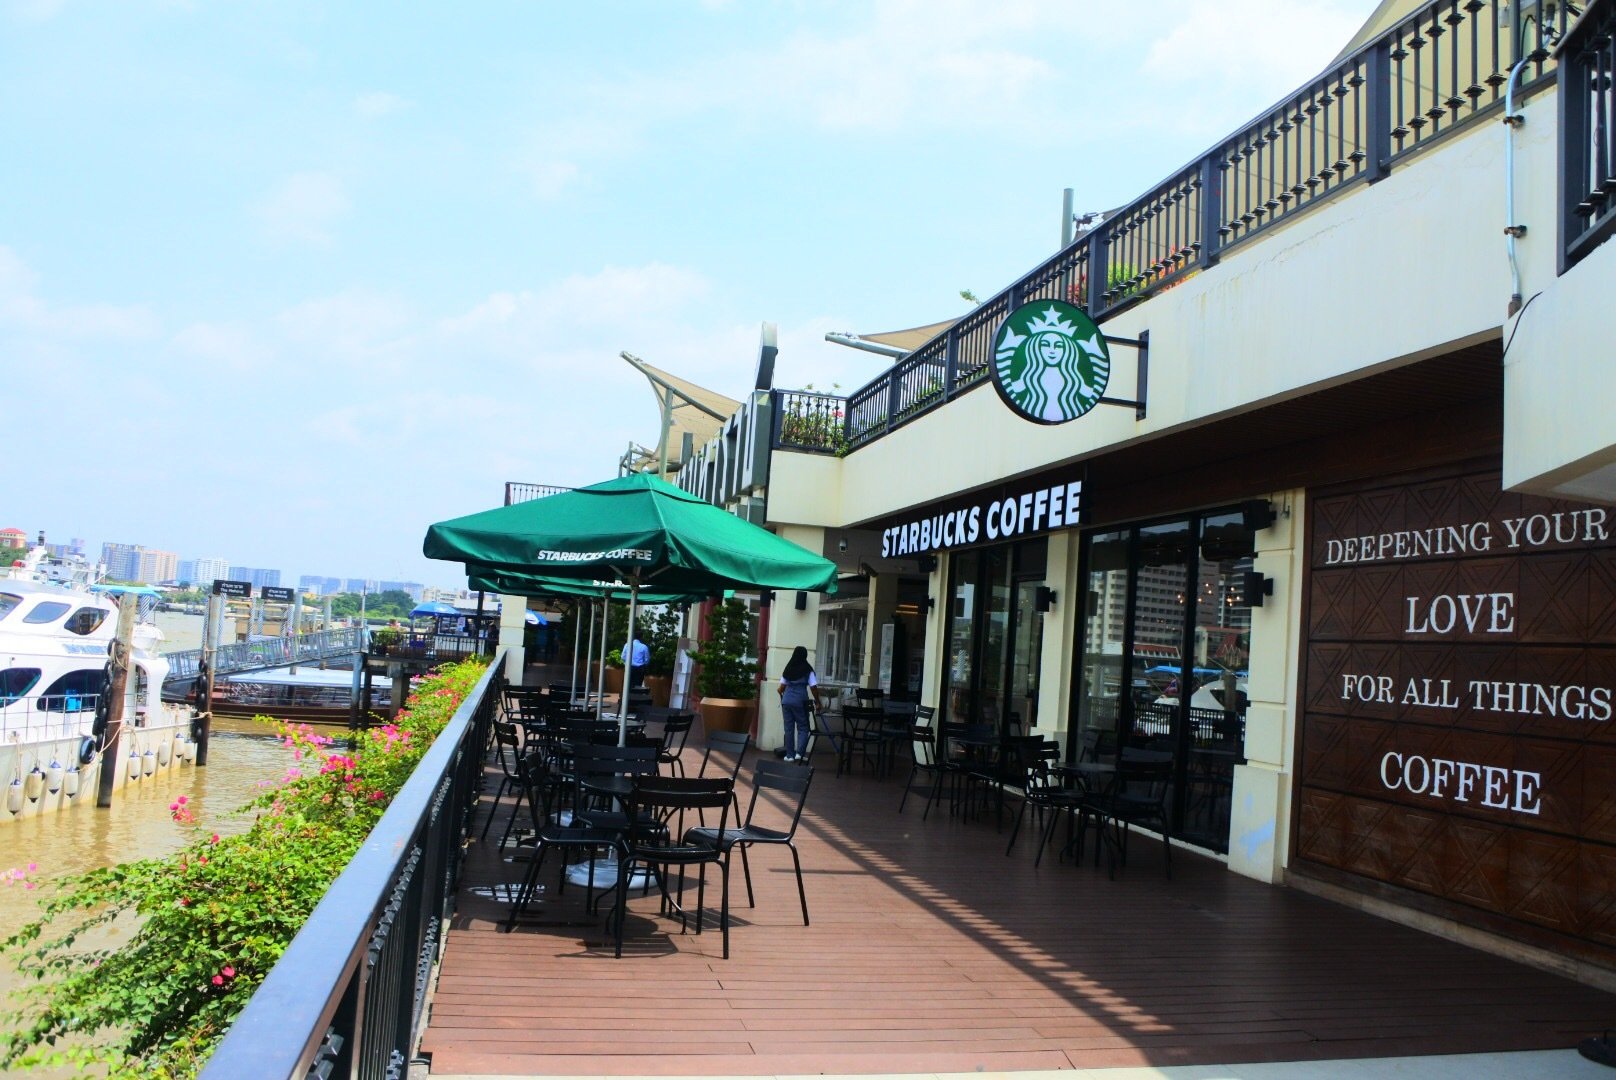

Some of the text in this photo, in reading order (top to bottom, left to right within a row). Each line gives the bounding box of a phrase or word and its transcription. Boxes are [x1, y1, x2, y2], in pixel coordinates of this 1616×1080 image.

[881, 480, 1082, 558] STARBUCKS COFFEE
[1325, 508, 1609, 565] DEEPENING YOUR
[537, 548, 653, 561] STARBUCKS COFFEE
[1405, 592, 1515, 634] LOVE
[1341, 674, 1612, 721] FOR ALL THINGS
[1380, 751, 1541, 815] COFFEE
